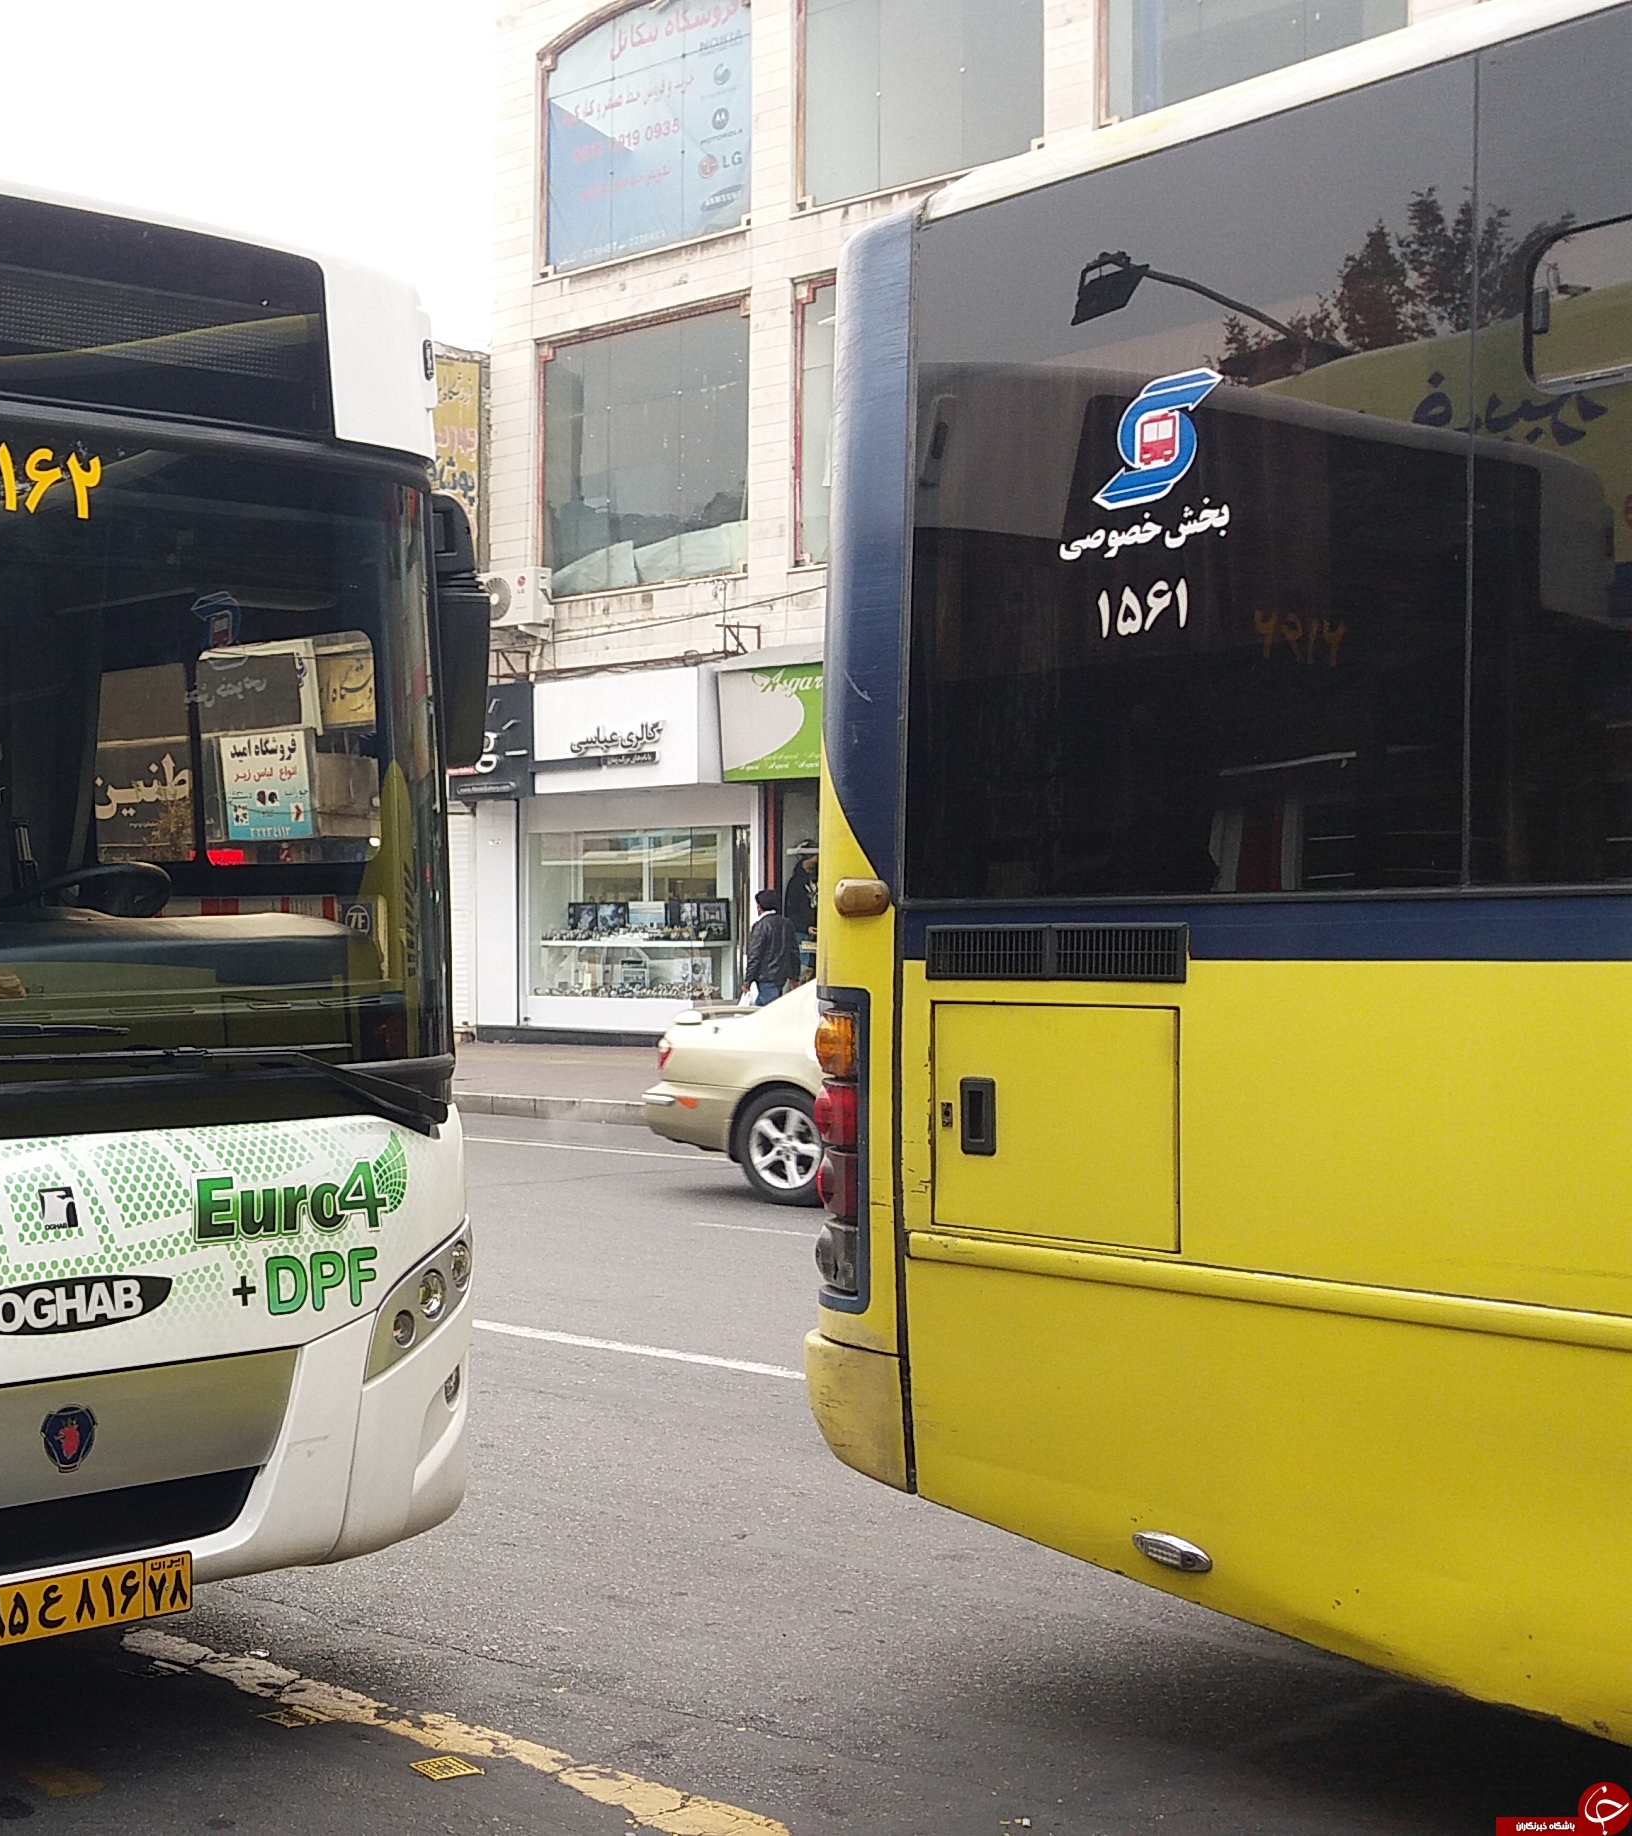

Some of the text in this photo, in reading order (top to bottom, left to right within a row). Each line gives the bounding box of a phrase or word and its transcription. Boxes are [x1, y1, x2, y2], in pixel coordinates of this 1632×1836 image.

[645, 117, 681, 142] 0935
[700, 128, 743, 145] MOTOROLA
[1058, 496, 1231, 561] بخش خصوصی
[1096, 577, 1189, 639] ۱۵۶۱
[230, 733, 297, 763] فروشگاه امید
[570, 720, 664, 754] گالری عباسی
[94, 752, 193, 820] طنین
[234, 769, 252, 782] زیر
[254, 767, 273, 782] لباس
[194, 1159, 388, 1243] Euro4
[265, 1246, 378, 1316] DPF
[150, 1556, 185, 1572] ایران
